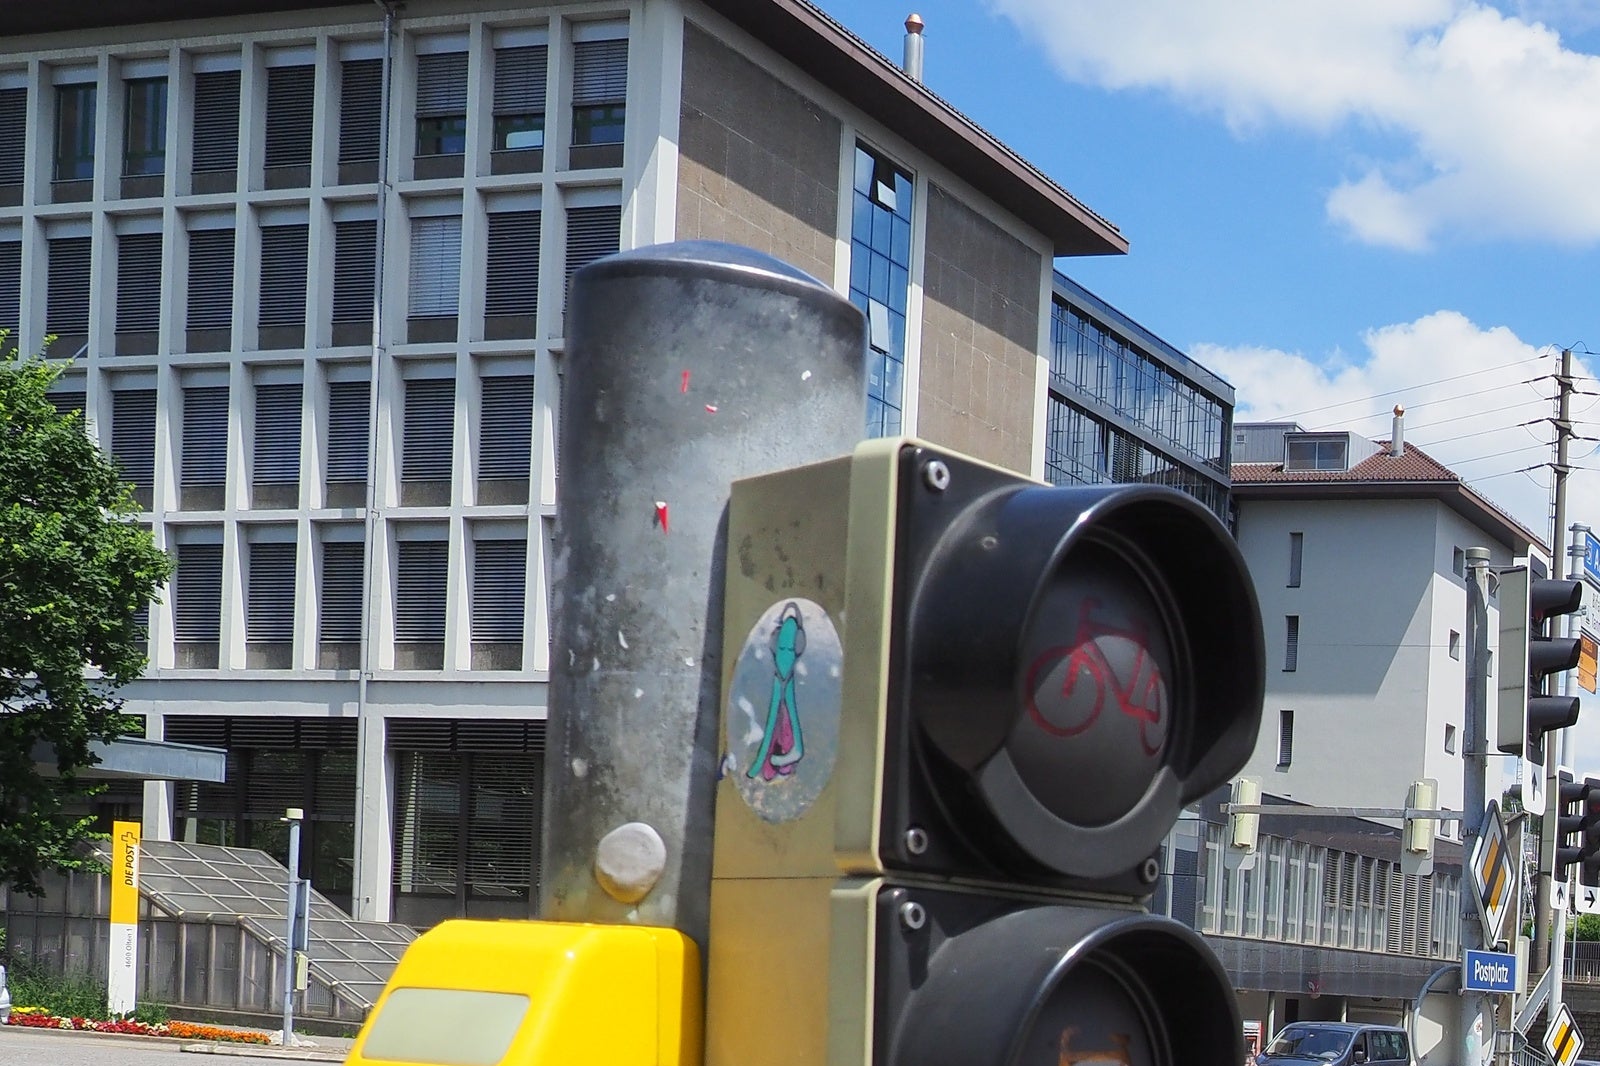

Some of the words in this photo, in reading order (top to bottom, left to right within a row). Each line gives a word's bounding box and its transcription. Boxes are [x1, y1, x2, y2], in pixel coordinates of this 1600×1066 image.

[126, 845, 135, 869] POST
[125, 870, 134, 886] DIE
[125, 934, 133, 951] Olten
[1474, 959, 1509, 987] Postplatz
